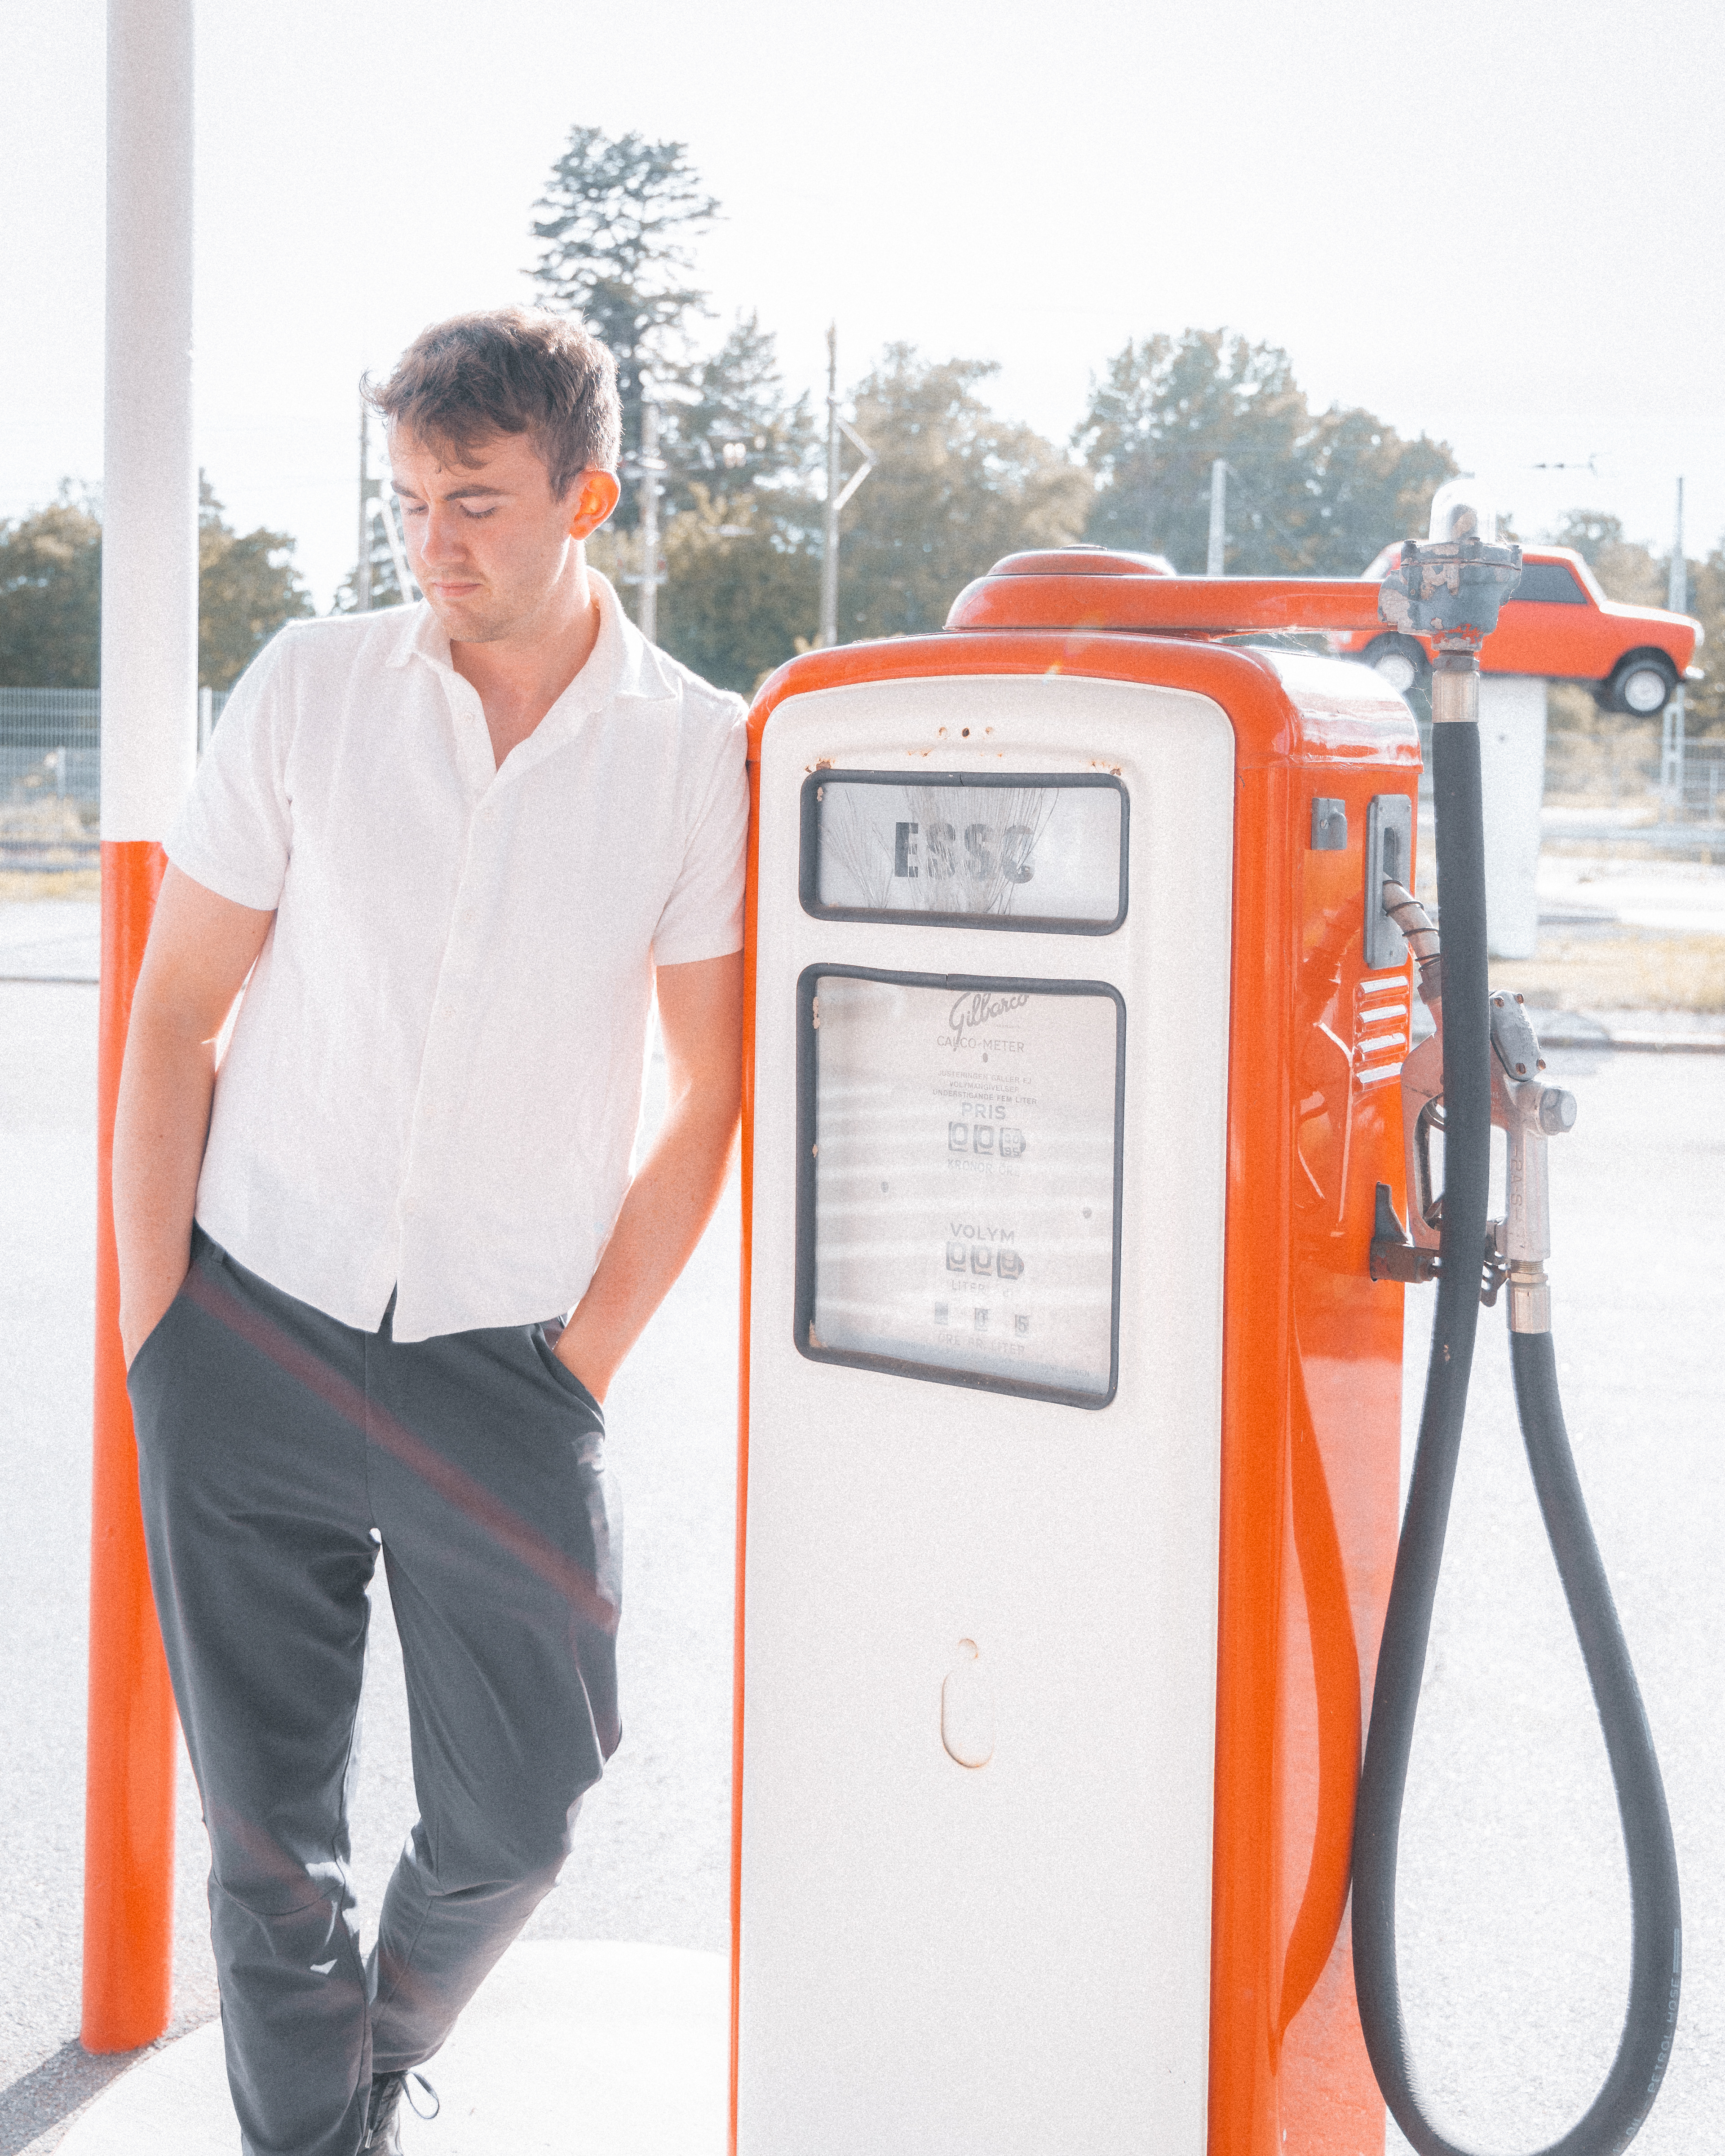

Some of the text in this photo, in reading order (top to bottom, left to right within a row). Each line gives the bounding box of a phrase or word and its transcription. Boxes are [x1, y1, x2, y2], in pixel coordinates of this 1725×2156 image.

[933, 1089, 994, 1100] UNDERSTIGANDE
[1015, 1096, 1037, 1105] LITER
[961, 1102, 1006, 1120] PRIS
[950, 1222, 1015, 1244] VOLYM
[1647, 2030, 1672, 2093] PETROL
[1666, 1977, 1680, 2023] HOSE
